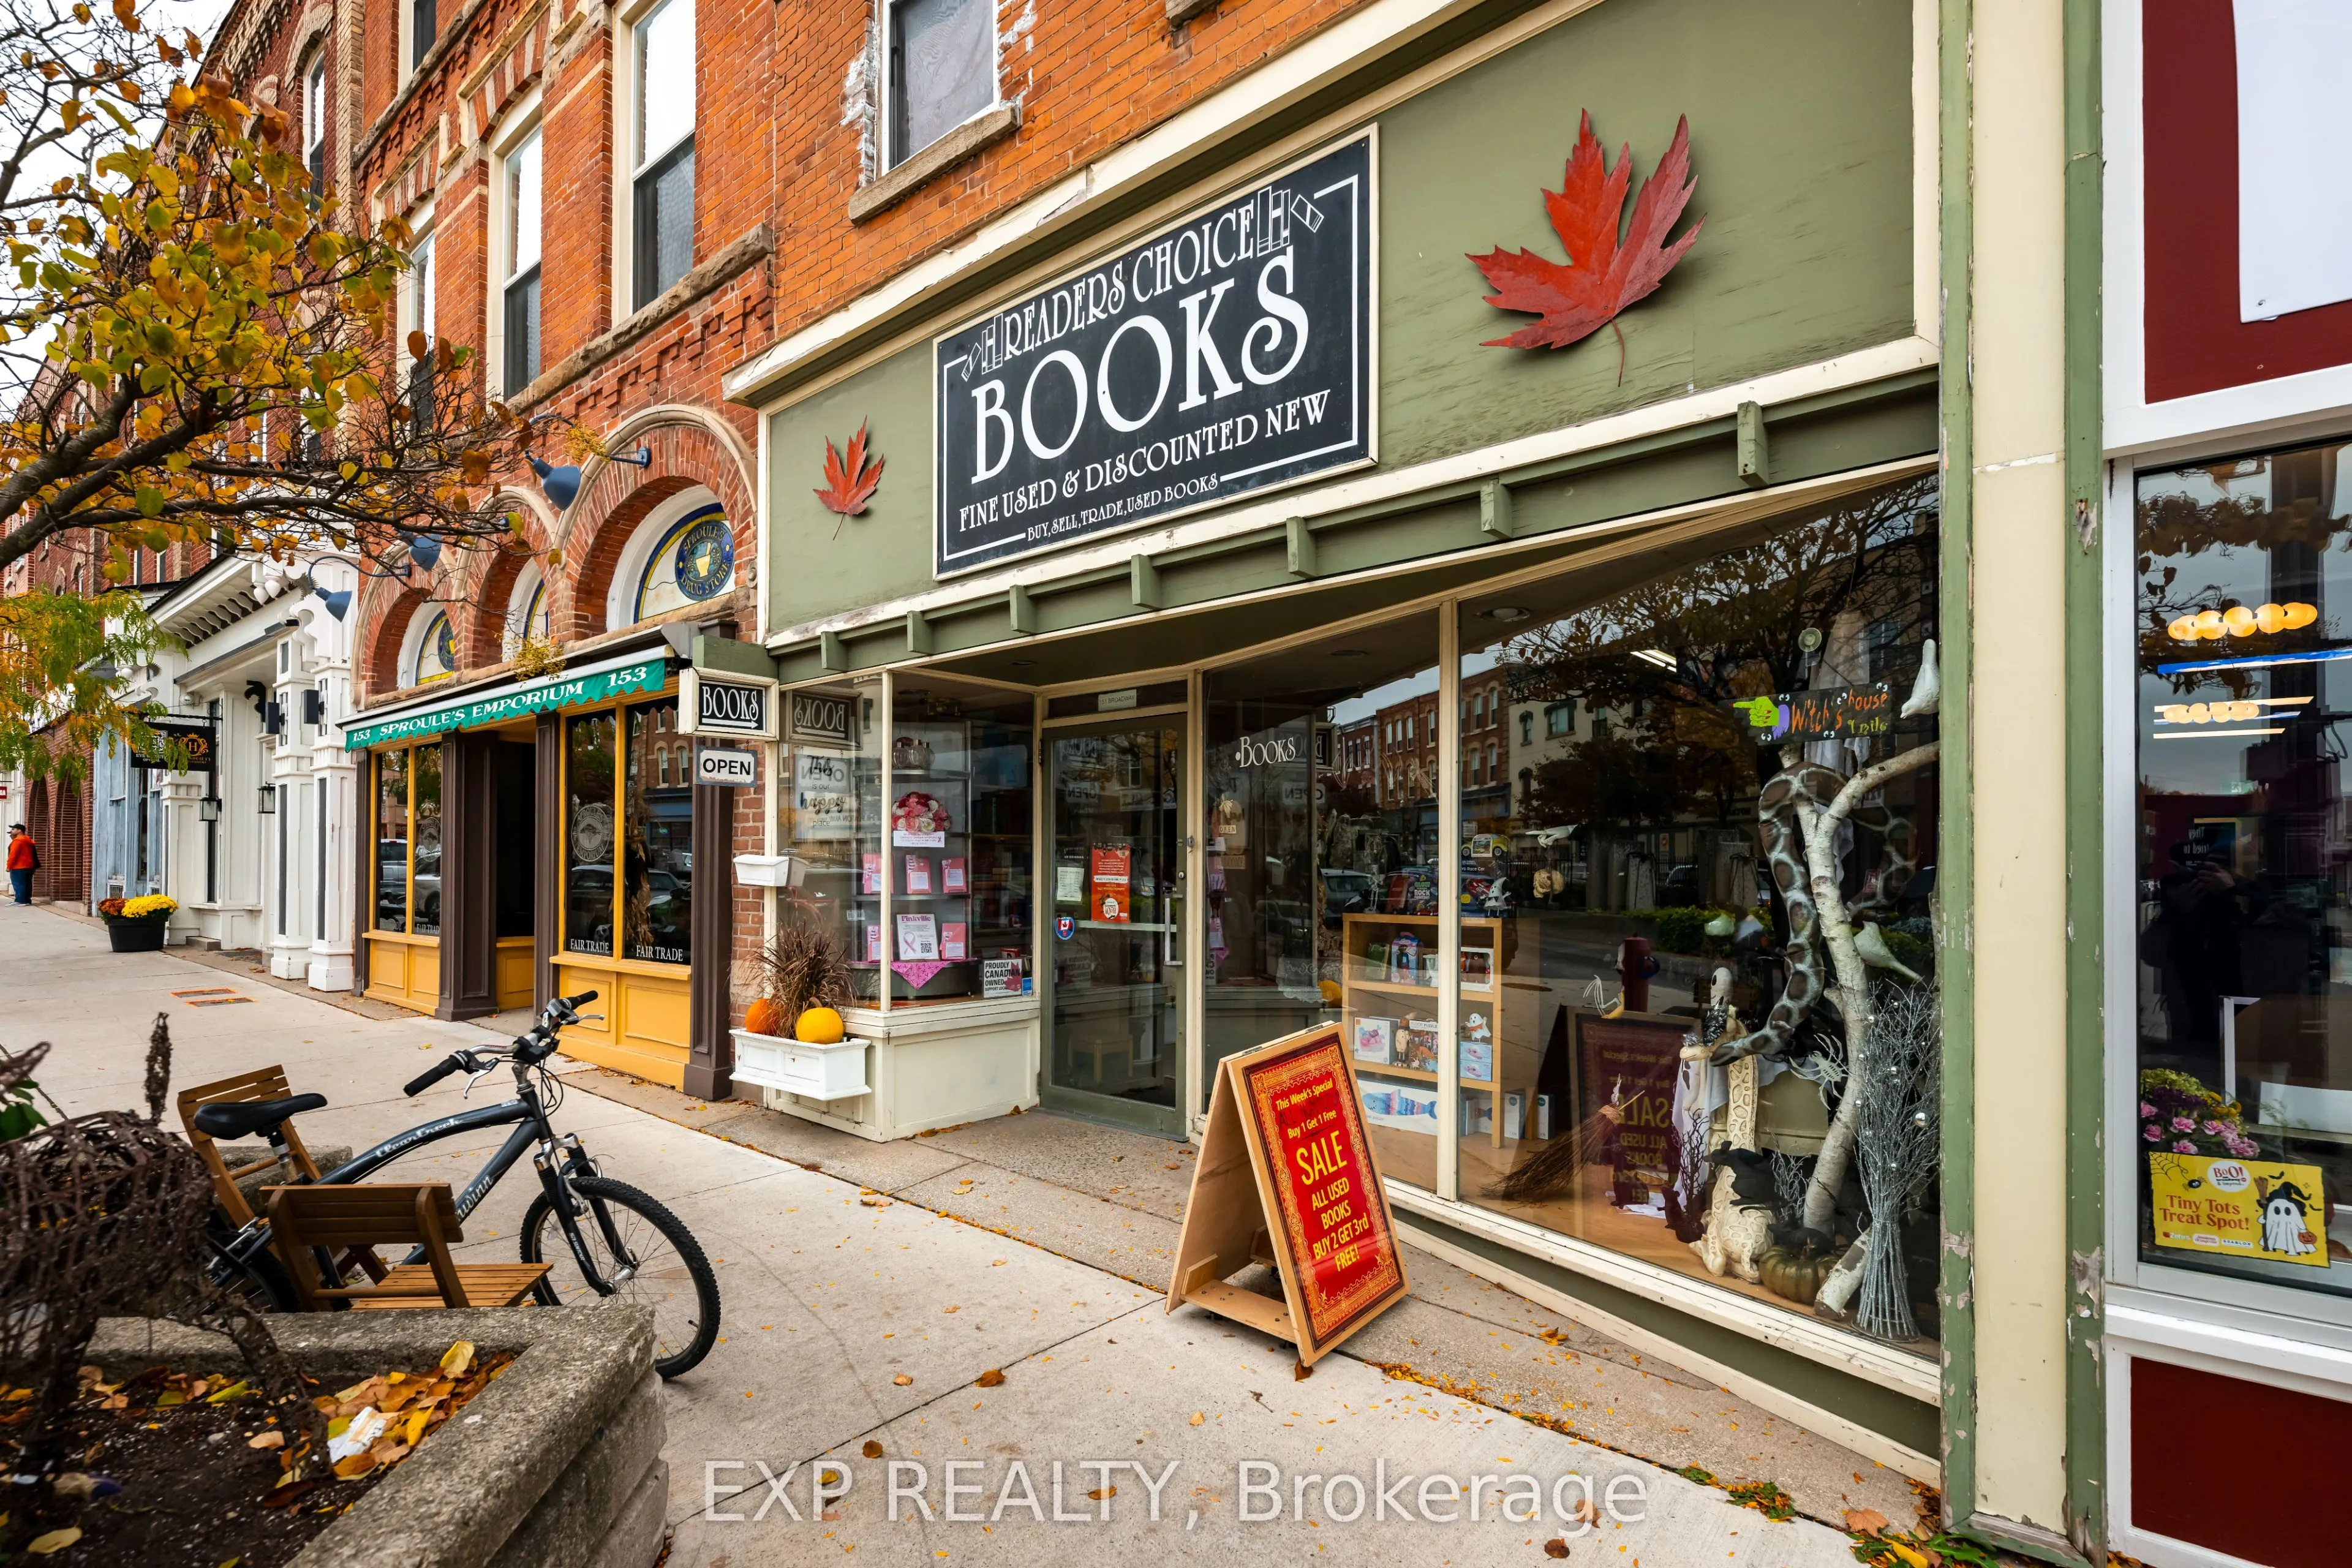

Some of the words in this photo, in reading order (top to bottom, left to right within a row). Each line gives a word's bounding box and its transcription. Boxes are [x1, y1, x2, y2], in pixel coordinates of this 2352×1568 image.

[1003, 262, 1125, 361] READERS
[1133, 200, 1256, 303] CHOICE
[970, 246, 1310, 485] BOOKS
[959, 504, 999, 532] FINE
[1002, 478, 1057, 517] USED
[1062, 470, 1080, 499] &
[1085, 414, 1258, 492] DISCOUNTED
[1265, 389, 1331, 437] NEW
[1127, 490, 1162, 511] USED
[1164, 473, 1218, 500] BOOKS
[680, 575, 703, 595] DRUG
[705, 561, 730, 593] STORE
[352, 729, 371, 742] 153
[379, 709, 466, 736] SPROULE'S
[472, 681, 584, 718] EMPORIUM
[606, 666, 647, 688] 153
[702, 685, 759, 721] BOOKS
[1108, 695, 1134, 703] BROADWAY
[1848, 688, 1888, 712] house
[189, 742, 197, 751] H
[703, 758, 751, 775] OPEN
[800, 792, 846, 815] happy
[813, 819, 831, 828] place
[428, 925, 440, 934] TRAD
[570, 938, 586, 951] FAIR
[586, 940, 609, 954] TRADE
[636, 945, 654, 959] FAIR
[655, 946, 683, 961] TRADE
[985, 968, 1020, 978] CANADIAN
[1276, 1098, 1289, 1110] This
[1290, 1088, 1312, 1105] Week's
[1312, 1078, 1333, 1097] Special
[1287, 1126, 1300, 1139] Buy
[1302, 1122, 1306, 1132] 1
[1306, 1117, 1318, 1129] Get
[1318, 1114, 1323, 1124] 1
[1323, 1110, 1336, 1121] Free
[1296, 1130, 1348, 1185] SALE
[1312, 1190, 1329, 1211] ALL
[1327, 1177, 1349, 1201] USED
[2166, 1195, 2201, 1213] Tiny
[2206, 1199, 2241, 1215] Tots
[1321, 1200, 1351, 1230] BOOKS
[2159, 1208, 2202, 1224] Treat
[2206, 1213, 2249, 1231] Spot!
[1313, 1235, 1331, 1260] BUY
[1331, 1232, 1339, 1251] 2
[1338, 1221, 1354, 1245] GET
[1352, 1213, 1369, 1236] 3rd
[1335, 1243, 1360, 1272] FREE!
